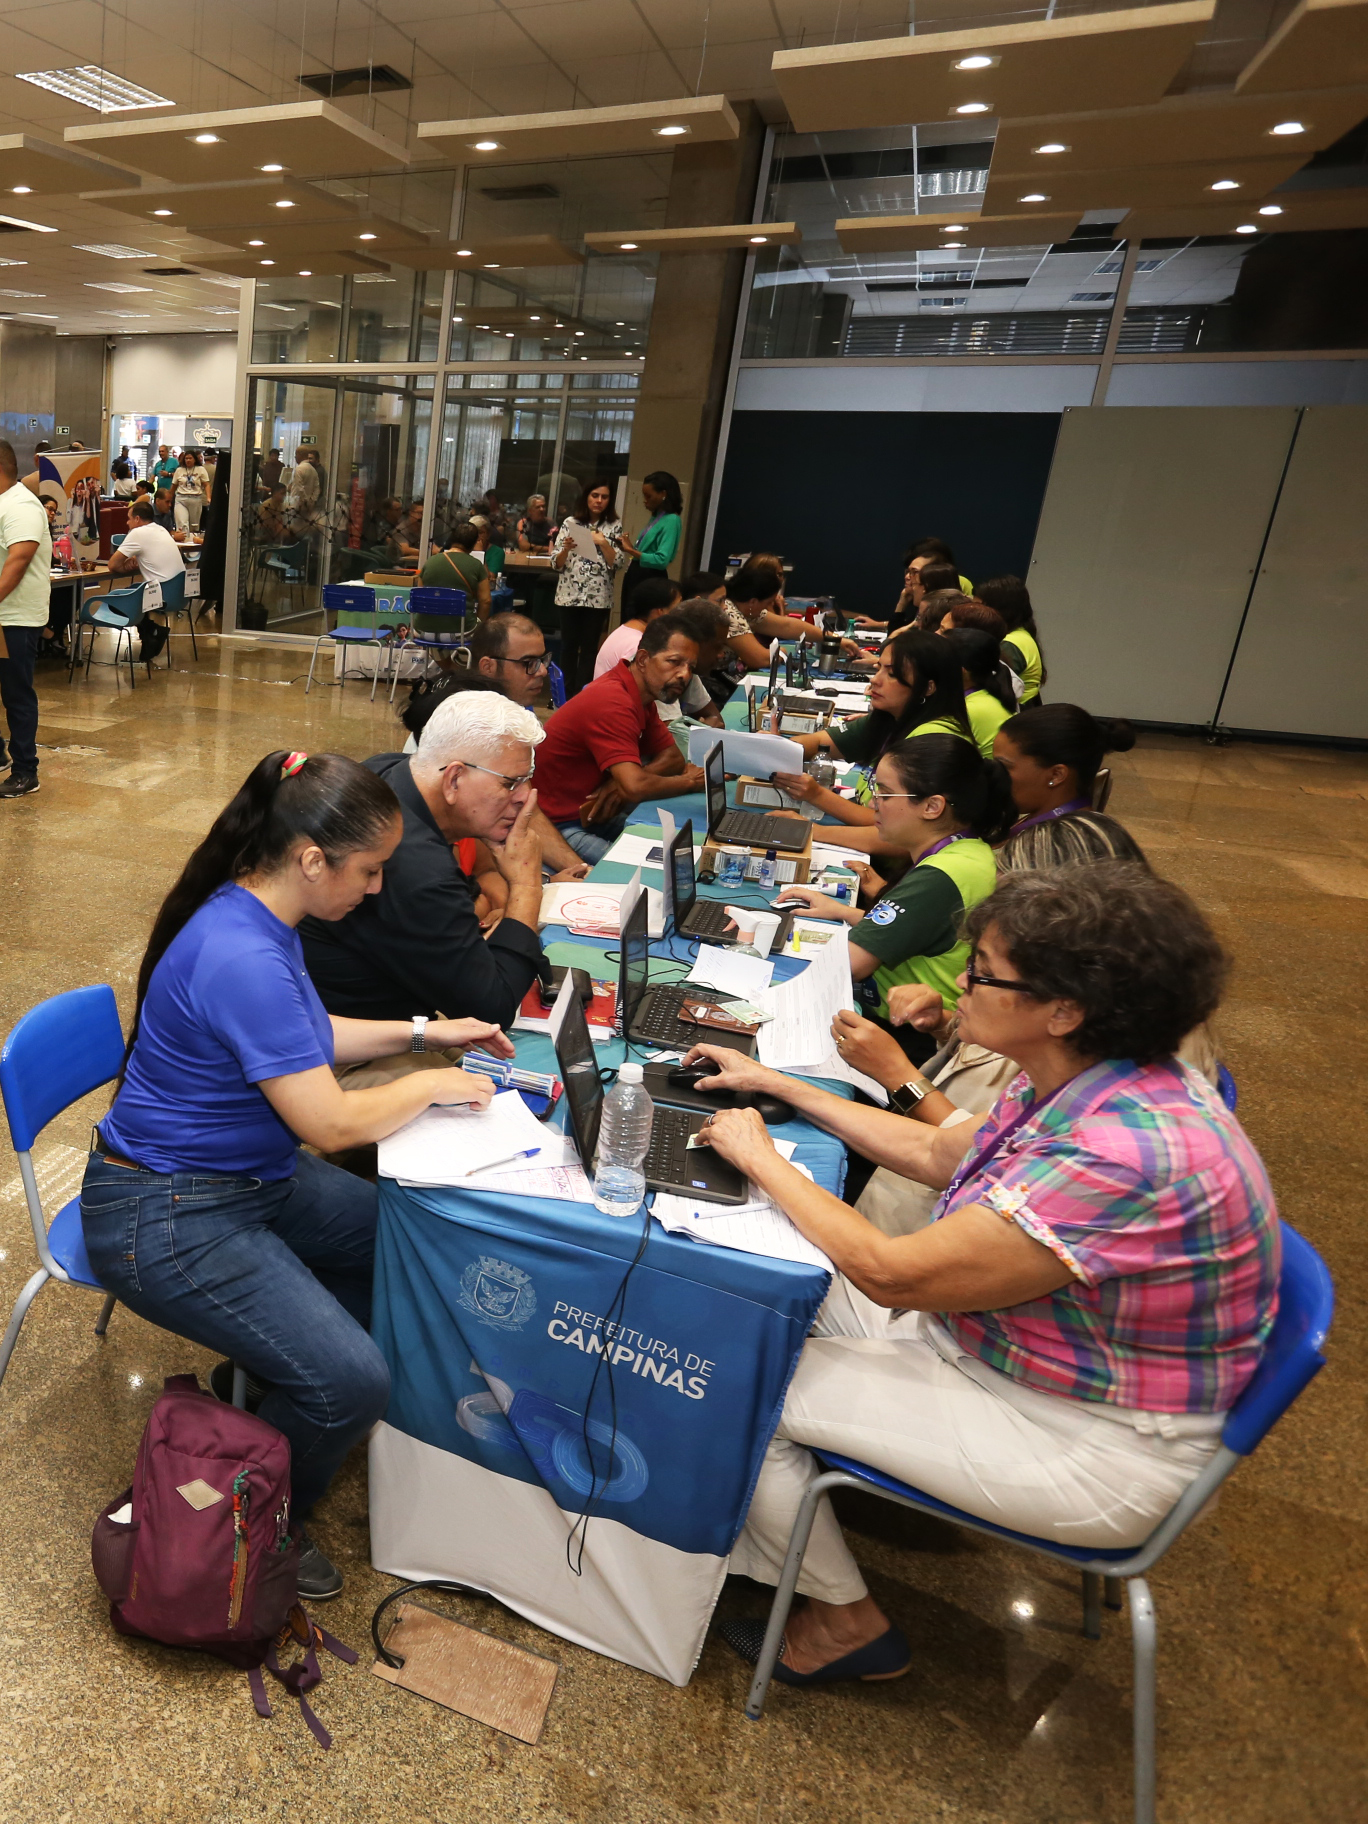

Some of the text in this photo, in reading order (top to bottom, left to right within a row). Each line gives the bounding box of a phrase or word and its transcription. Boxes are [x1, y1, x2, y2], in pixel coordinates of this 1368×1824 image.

[547, 1319, 709, 1400] CAMPINAS
[553, 1300, 716, 1378] PREFEITURA DE
